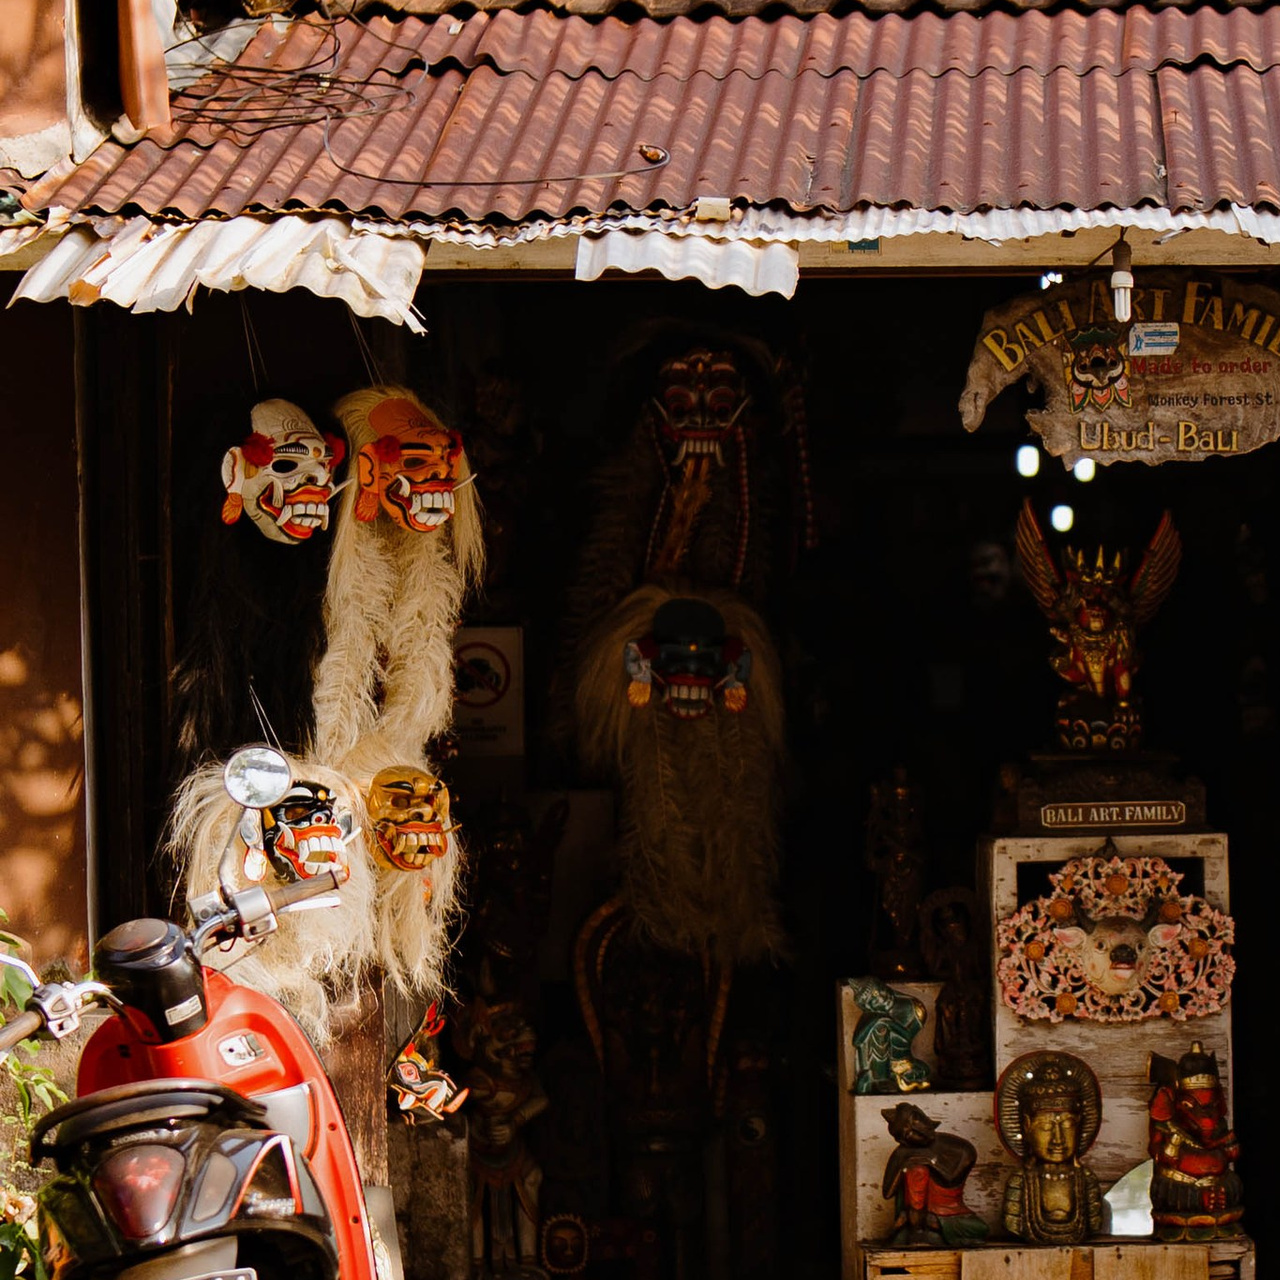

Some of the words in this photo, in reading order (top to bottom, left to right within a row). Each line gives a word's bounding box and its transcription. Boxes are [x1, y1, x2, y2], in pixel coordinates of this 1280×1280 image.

[983, 299, 1077, 372] BALI
[1131, 357, 1184, 375] Made
[1191, 357, 1212, 374] to
[1218, 357, 1273, 374] order
[1147, 392, 1199, 409] Monkey
[1203, 392, 1250, 407] Forest
[1079, 420, 1155, 451] Ubud
[1046, 808, 1084, 823] BALI
[1125, 805, 1182, 821] FAMILY
